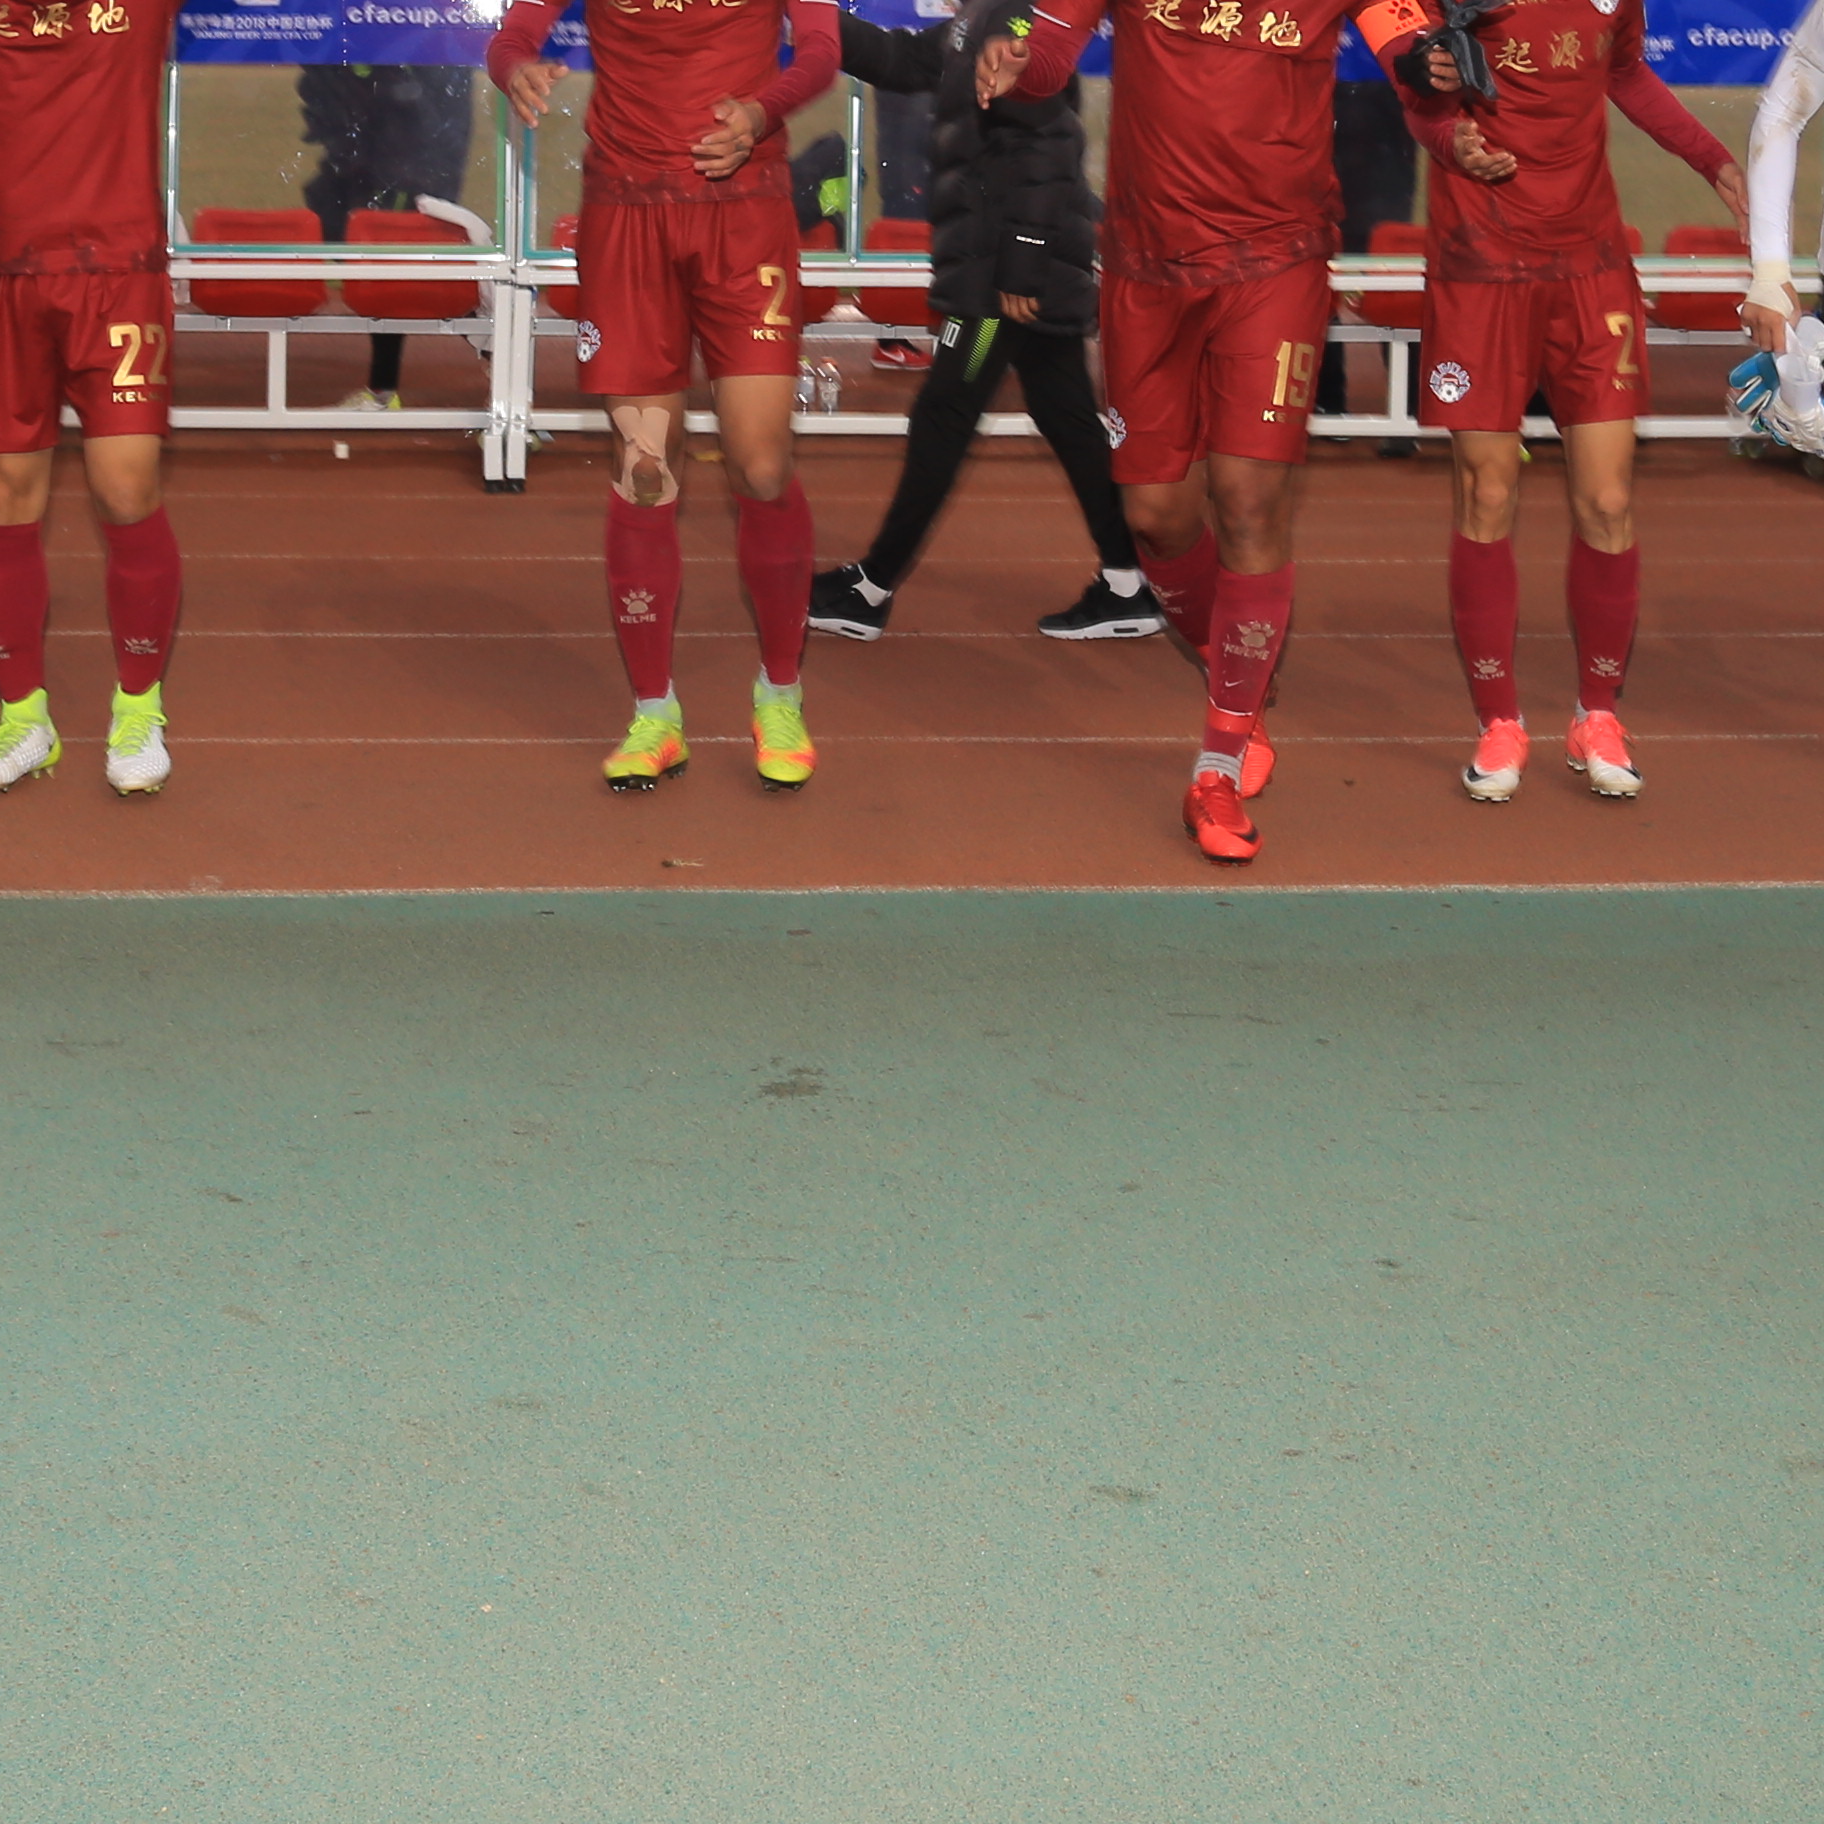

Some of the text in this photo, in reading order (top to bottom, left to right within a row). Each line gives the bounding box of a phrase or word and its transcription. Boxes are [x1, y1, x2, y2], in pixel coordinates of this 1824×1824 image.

[346, 0, 494, 28] cfacup.co
[1687, 23, 1795, 50] cfacup.c
[759, 265, 792, 326] 2
[753, 328, 786, 340] KEL
[108, 323, 167, 386] 22
[1272, 341, 1316, 408] 19
[112, 391, 156, 403] KEL
[620, 614, 656, 624] KELME
[1473, 670, 1505, 681] KELME
